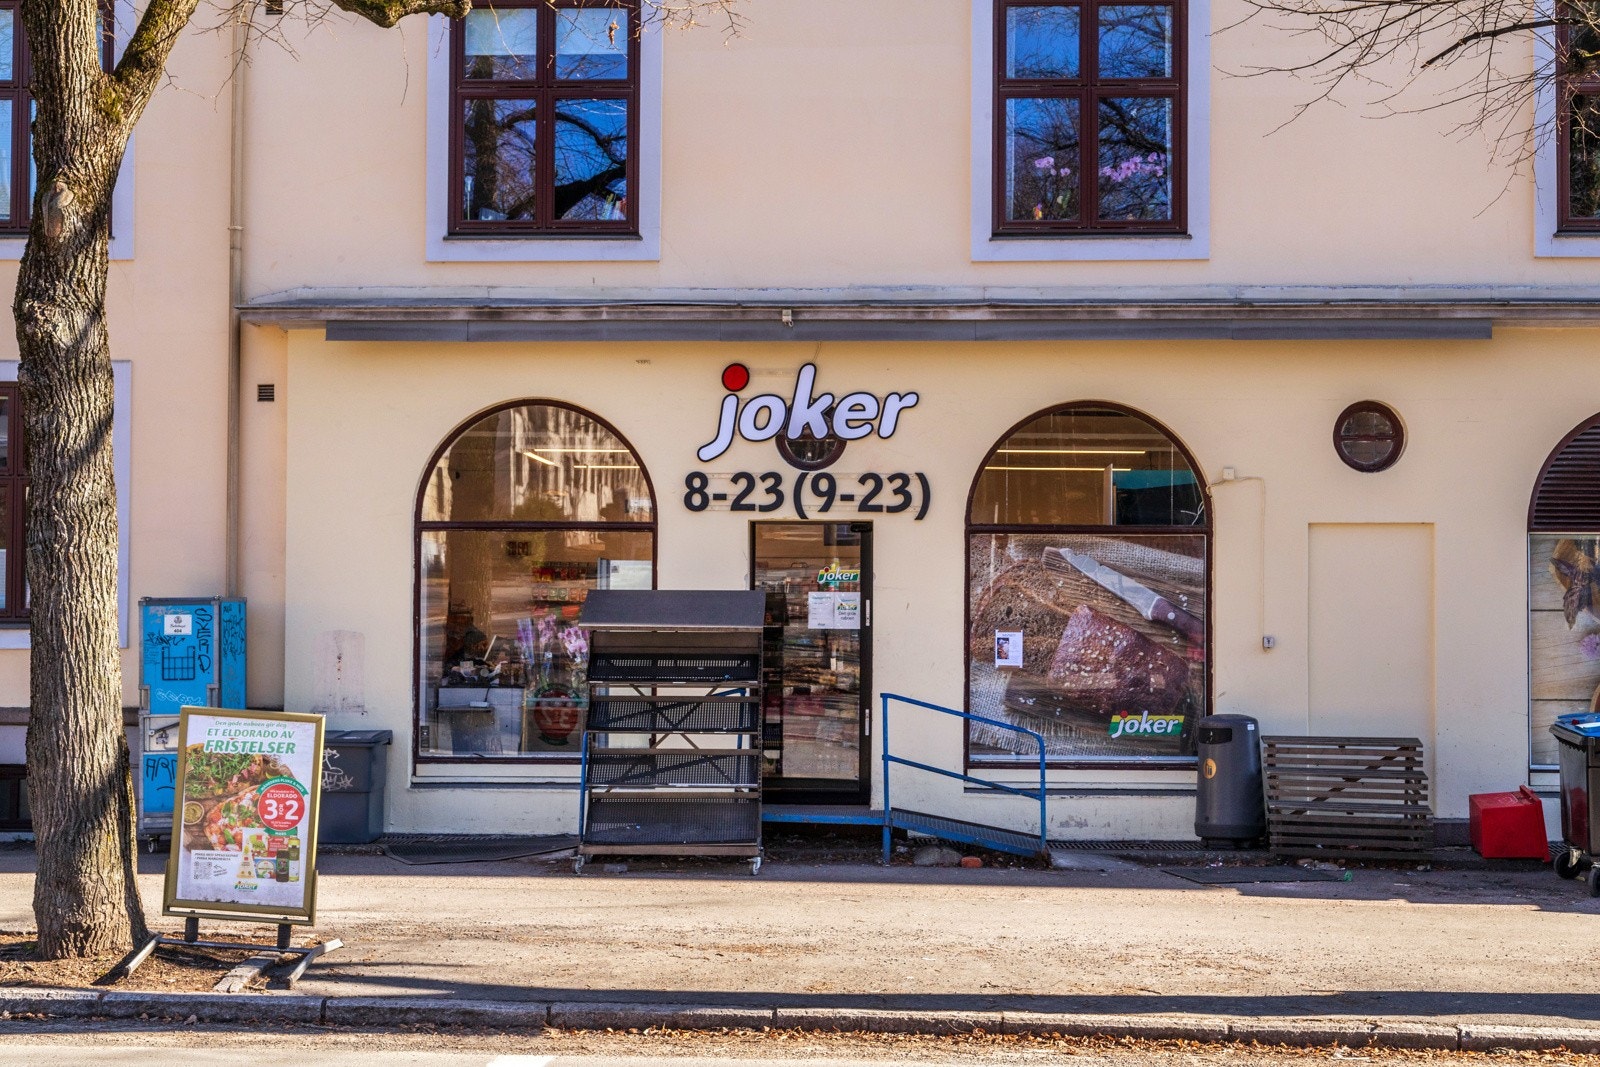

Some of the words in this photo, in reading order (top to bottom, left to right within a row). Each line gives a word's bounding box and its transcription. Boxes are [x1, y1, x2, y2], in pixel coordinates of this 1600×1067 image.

[697, 363, 919, 462] joker
[817, 566, 857, 584] joker
[207, 728, 220, 736] ET
[222, 729, 279, 738] ELDORADO
[280, 730, 295, 739] AV
[1111, 710, 1179, 739] joker
[204, 739, 296, 754] FRISTELSER
[264, 799, 278, 820] 3
[285, 799, 299, 820] 2
